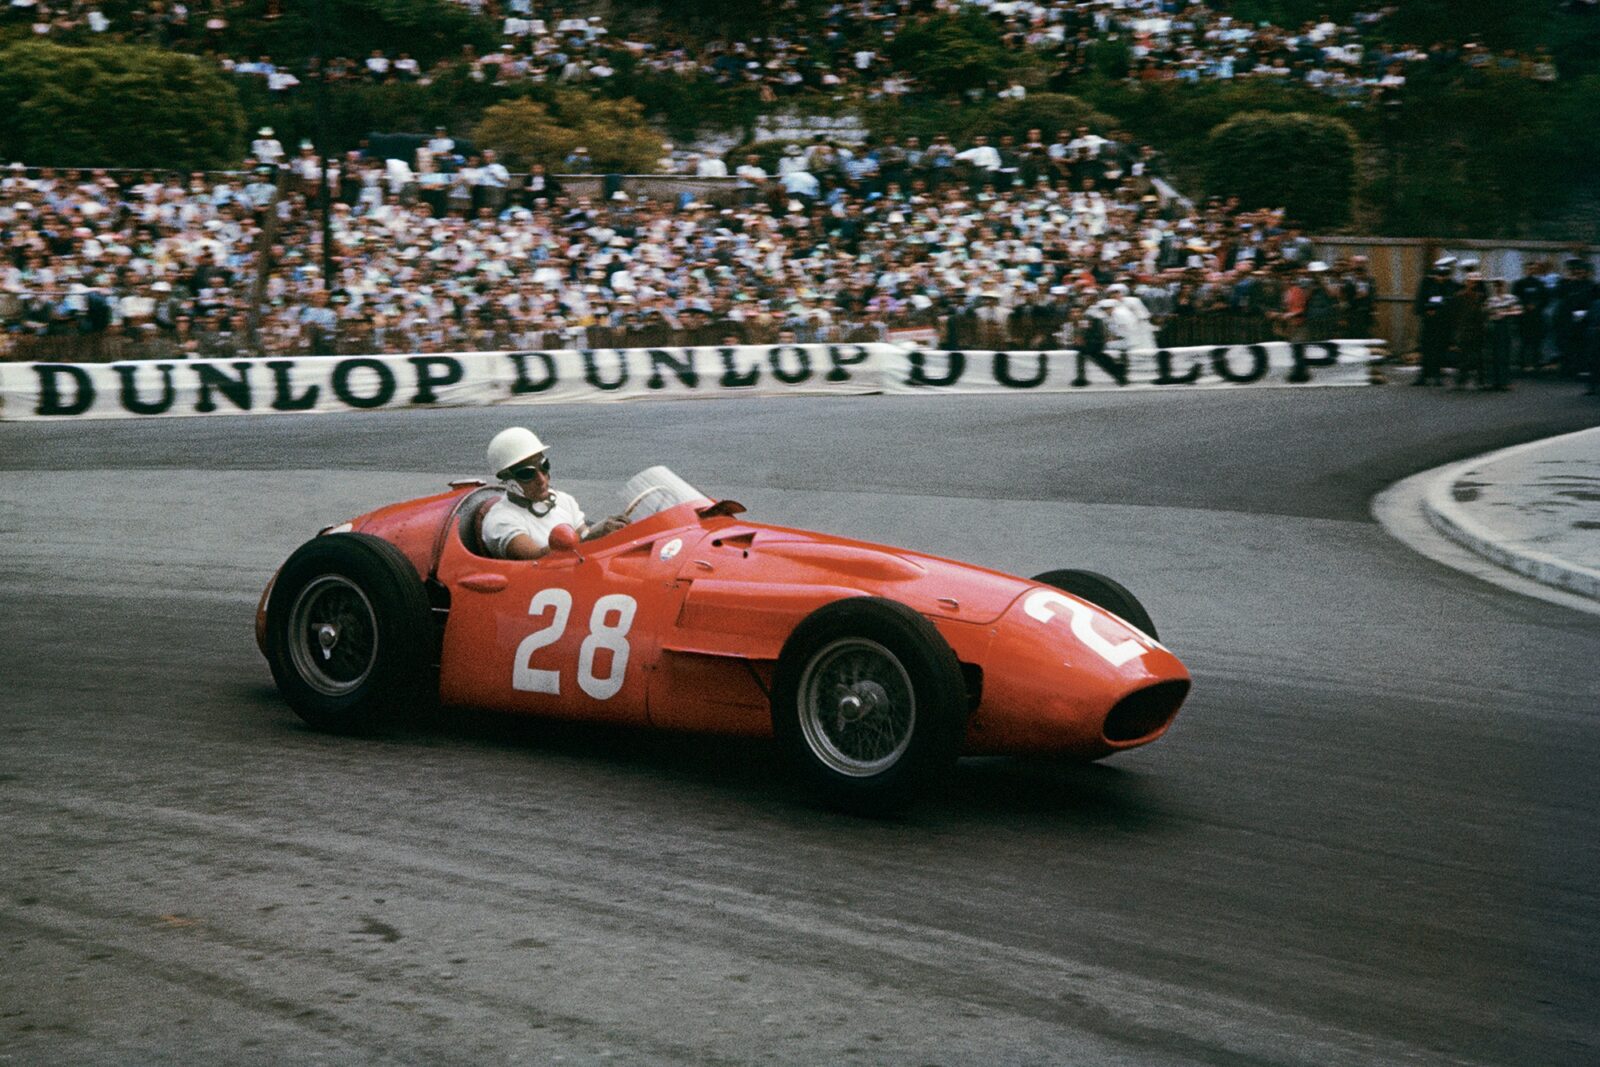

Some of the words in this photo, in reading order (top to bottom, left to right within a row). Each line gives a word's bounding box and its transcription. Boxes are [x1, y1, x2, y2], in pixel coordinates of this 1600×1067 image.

[33, 355, 464, 415] DUNLOP
[508, 345, 869, 394] DUNLOP
[903, 341, 1340, 388] DUNLOP
[512, 587, 638, 700] 28
[1023, 590, 1172, 668] 2
